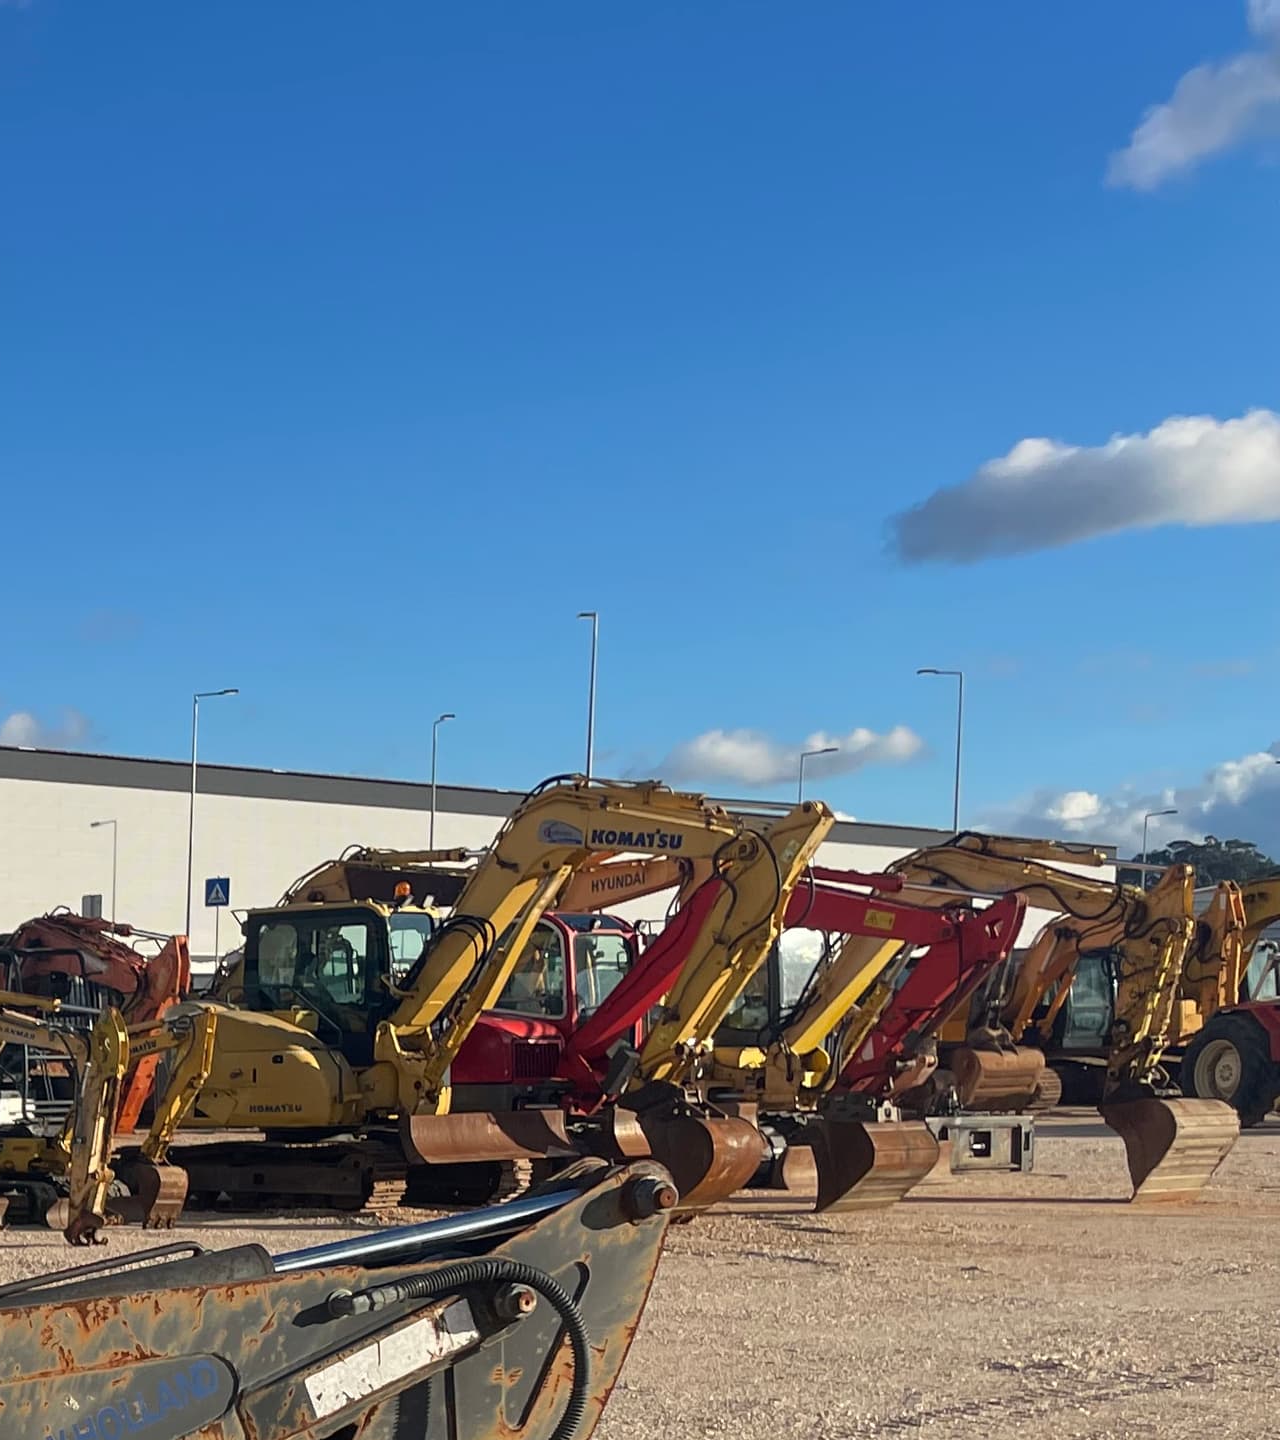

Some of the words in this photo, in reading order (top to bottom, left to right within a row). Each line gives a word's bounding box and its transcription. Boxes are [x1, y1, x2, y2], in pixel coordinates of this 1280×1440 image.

[591, 829, 683, 849] KOMATSU
[591, 872, 646, 893] HYUNDAI
[248, 1104, 303, 1113] KOMATSU
